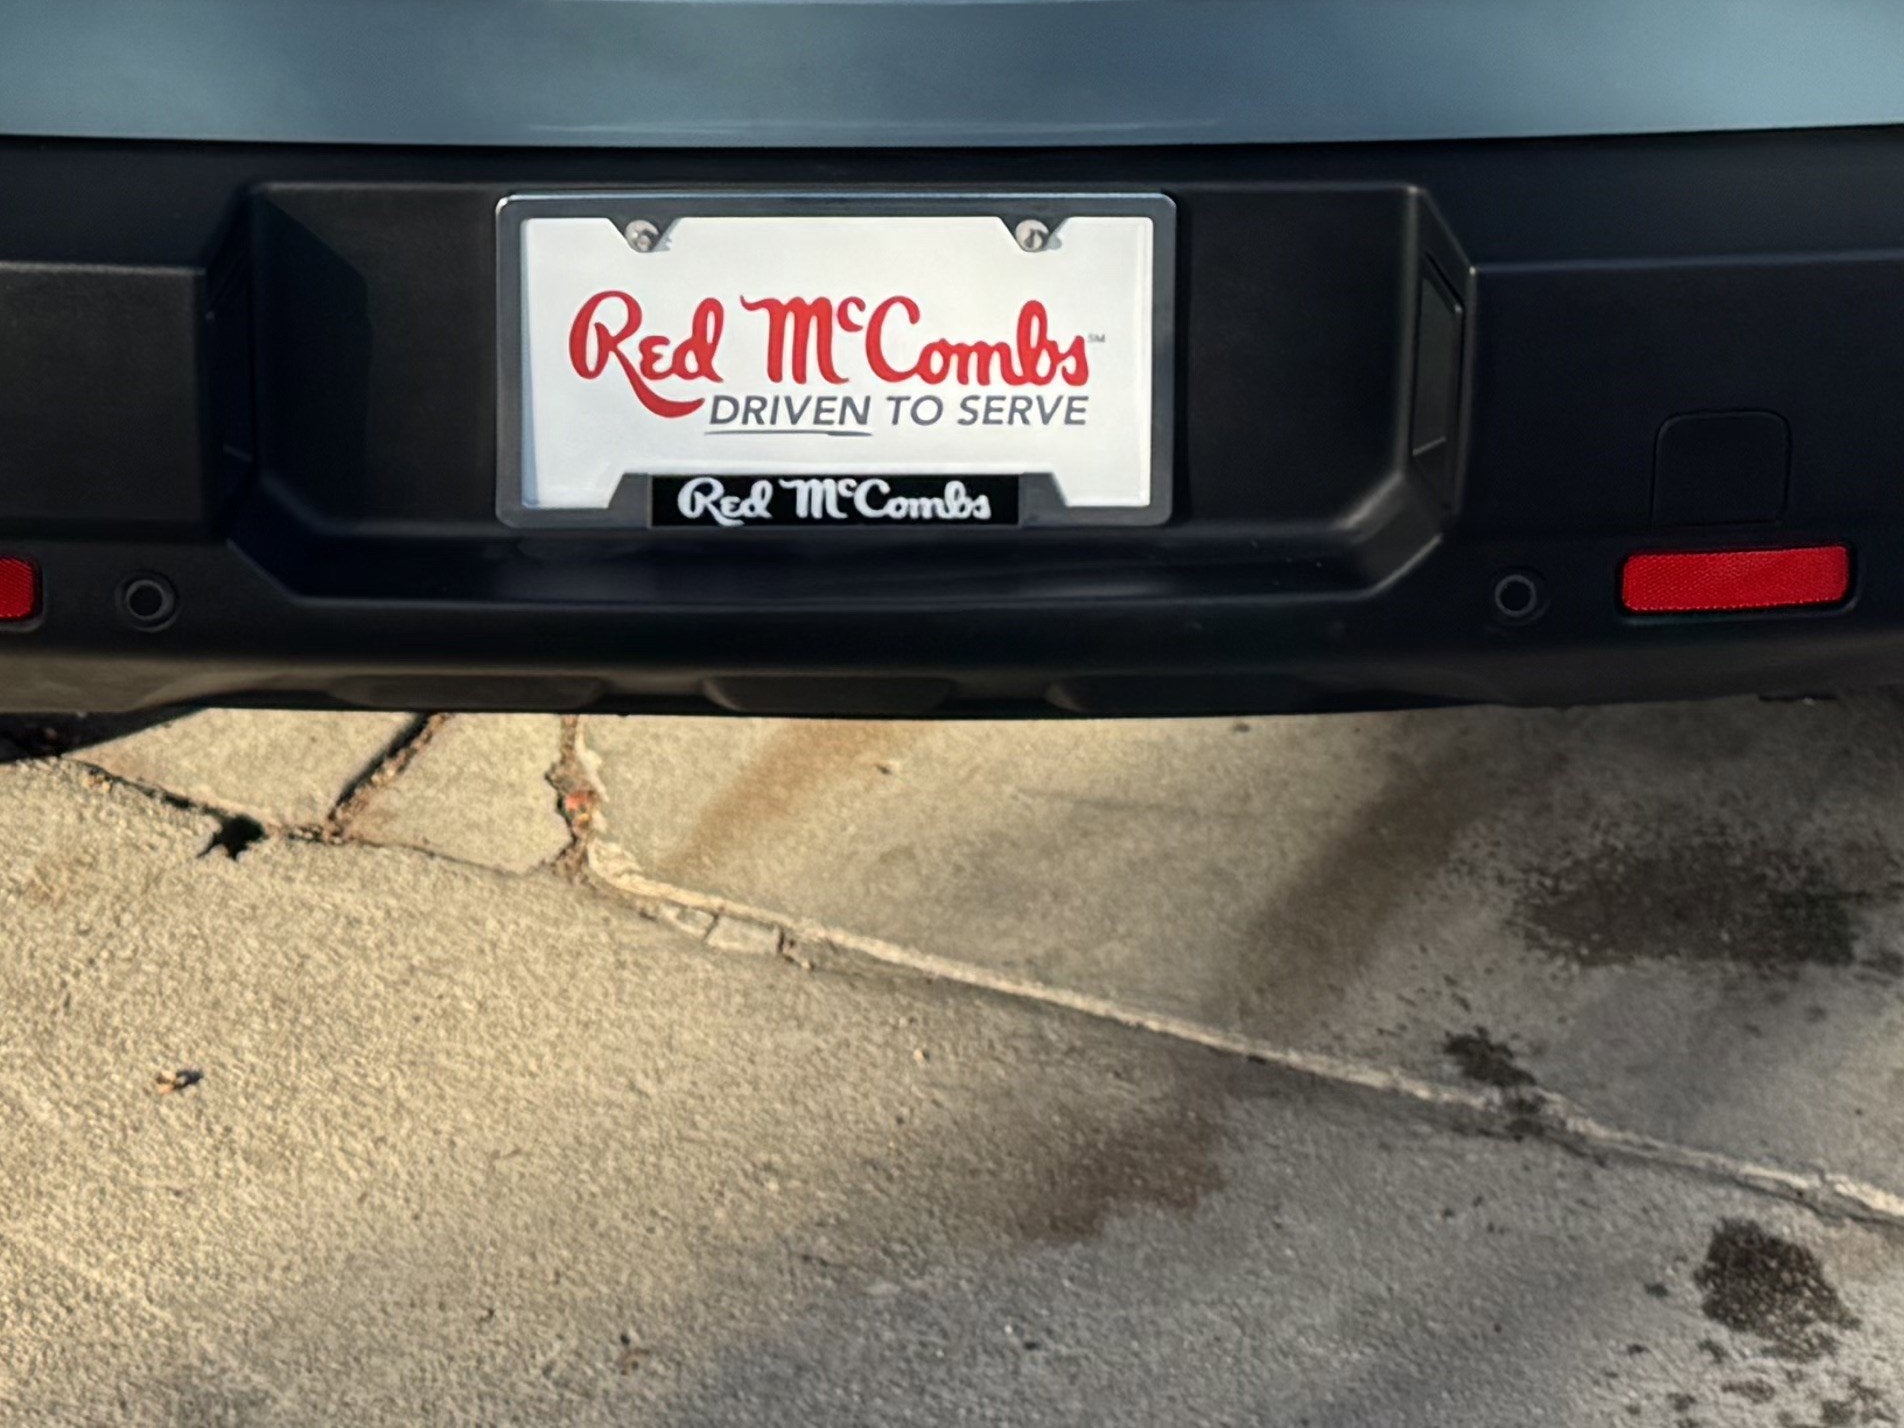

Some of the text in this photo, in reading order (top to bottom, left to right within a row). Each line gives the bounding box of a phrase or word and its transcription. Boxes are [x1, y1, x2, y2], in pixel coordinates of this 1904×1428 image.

[569, 290, 724, 419] Red
[739, 294, 1090, 386] McCombs
[709, 395, 1090, 426] DRIVEN TO SERVE
[677, 477, 991, 525] Red McCombs
